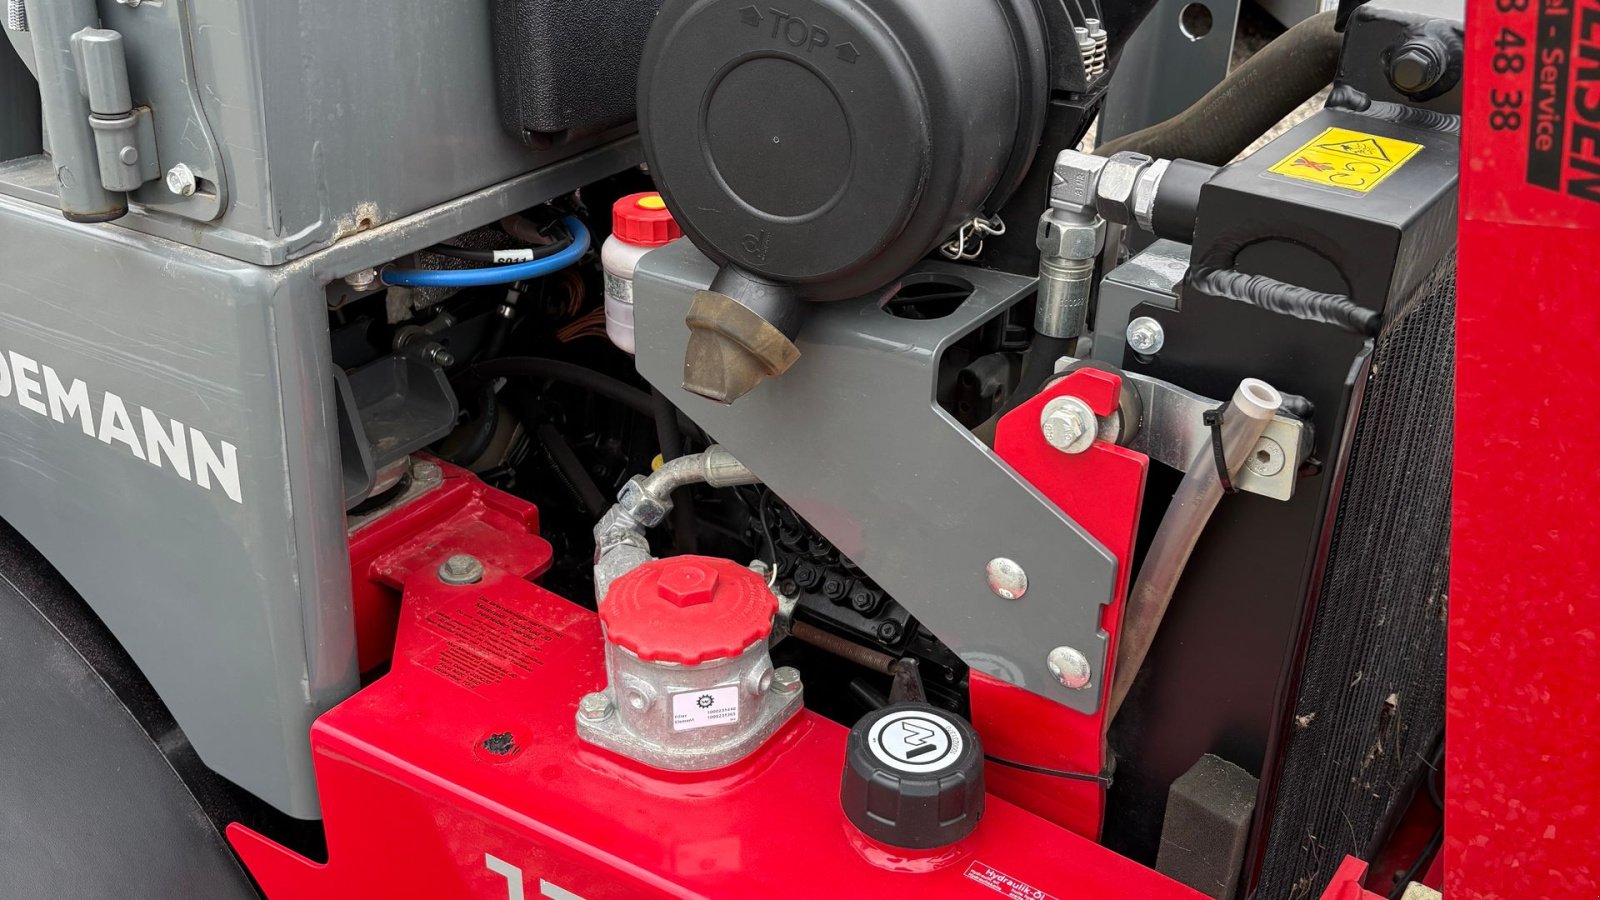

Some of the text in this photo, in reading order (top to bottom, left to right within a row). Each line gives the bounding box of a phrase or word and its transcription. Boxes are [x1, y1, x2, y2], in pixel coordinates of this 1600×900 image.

[767, 6, 831, 53] TOP
[1492, 28, 1527, 74] 48
[1489, 89, 1523, 131] 38
[1535, 48, 1564, 151] Service
